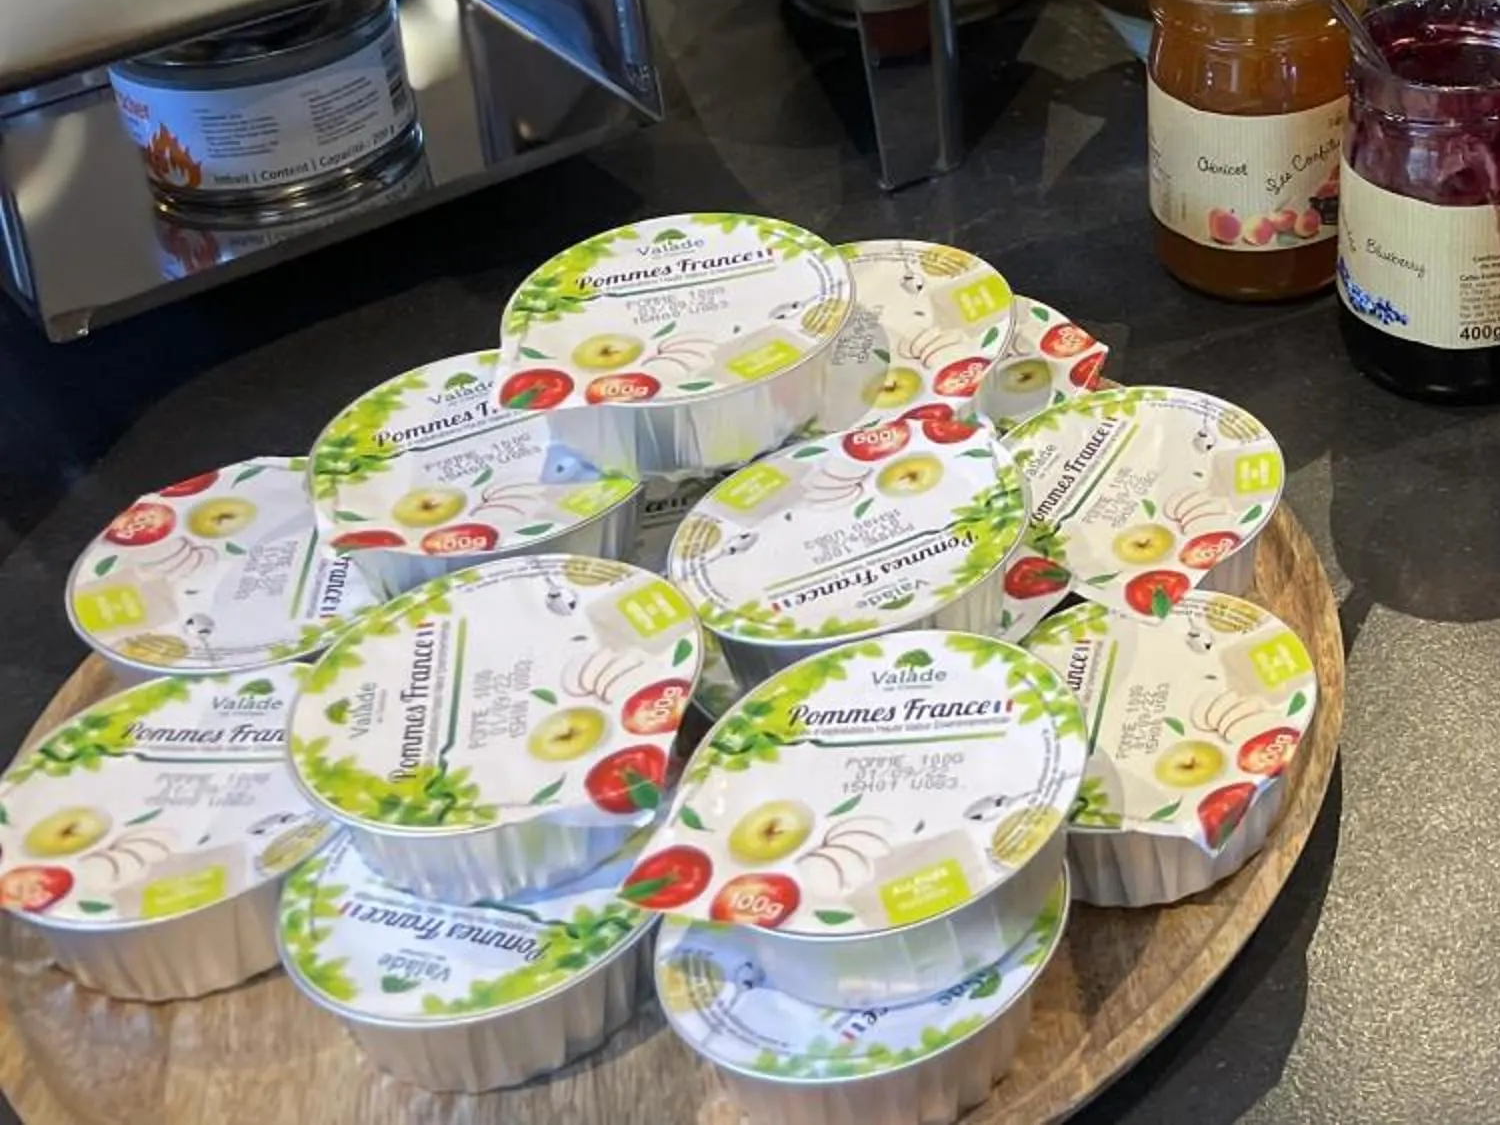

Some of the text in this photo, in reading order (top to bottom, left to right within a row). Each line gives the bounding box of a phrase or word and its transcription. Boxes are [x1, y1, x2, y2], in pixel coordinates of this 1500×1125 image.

[575, 248, 756, 291] Pommes France
[372, 412, 473, 448] Pommes
[1065, 422, 1114, 474] France
[880, 531, 979, 574] Pommes
[320, 555, 351, 606] rance
[792, 570, 879, 607] France
[870, 667, 947, 686] Valade
[212, 695, 284, 712] Valade
[391, 637, 436, 784] Pommes France
[788, 698, 991, 728] Pommes France
[121, 722, 286, 745] Pommes Fran
[730, 892, 784, 921] 100g
[357, 906, 552, 964] Pommes France
